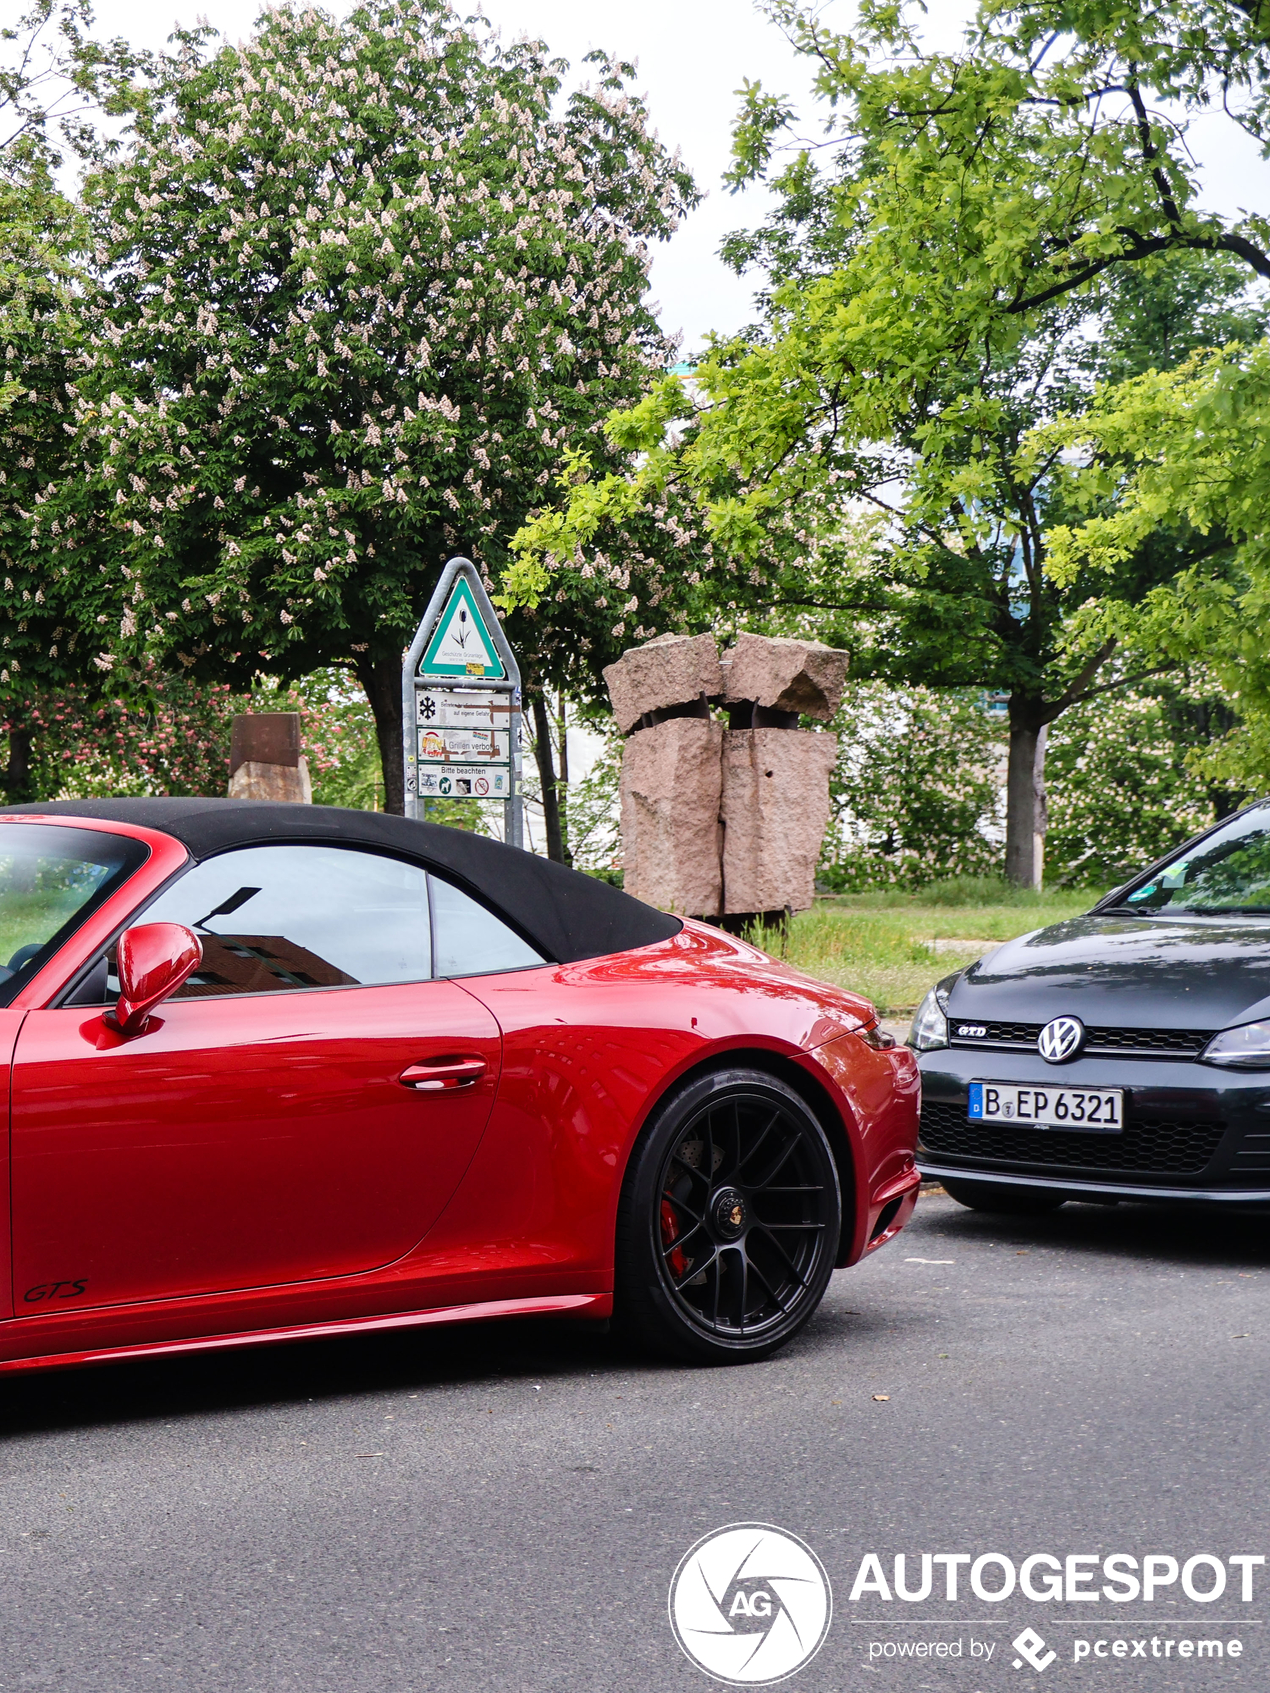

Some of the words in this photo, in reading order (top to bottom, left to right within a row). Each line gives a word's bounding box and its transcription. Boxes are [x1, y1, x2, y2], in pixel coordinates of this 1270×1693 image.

[449, 741, 471, 750] Grillen
[441, 766, 456, 774] Bitte
[456, 766, 486, 775] beachten
[958, 1026, 987, 1038] GTD
[985, 1088, 1000, 1115] B
[1017, 1090, 1048, 1119] EP
[1054, 1093, 1119, 1124] 6321
[23, 1278, 89, 1303] GTS
